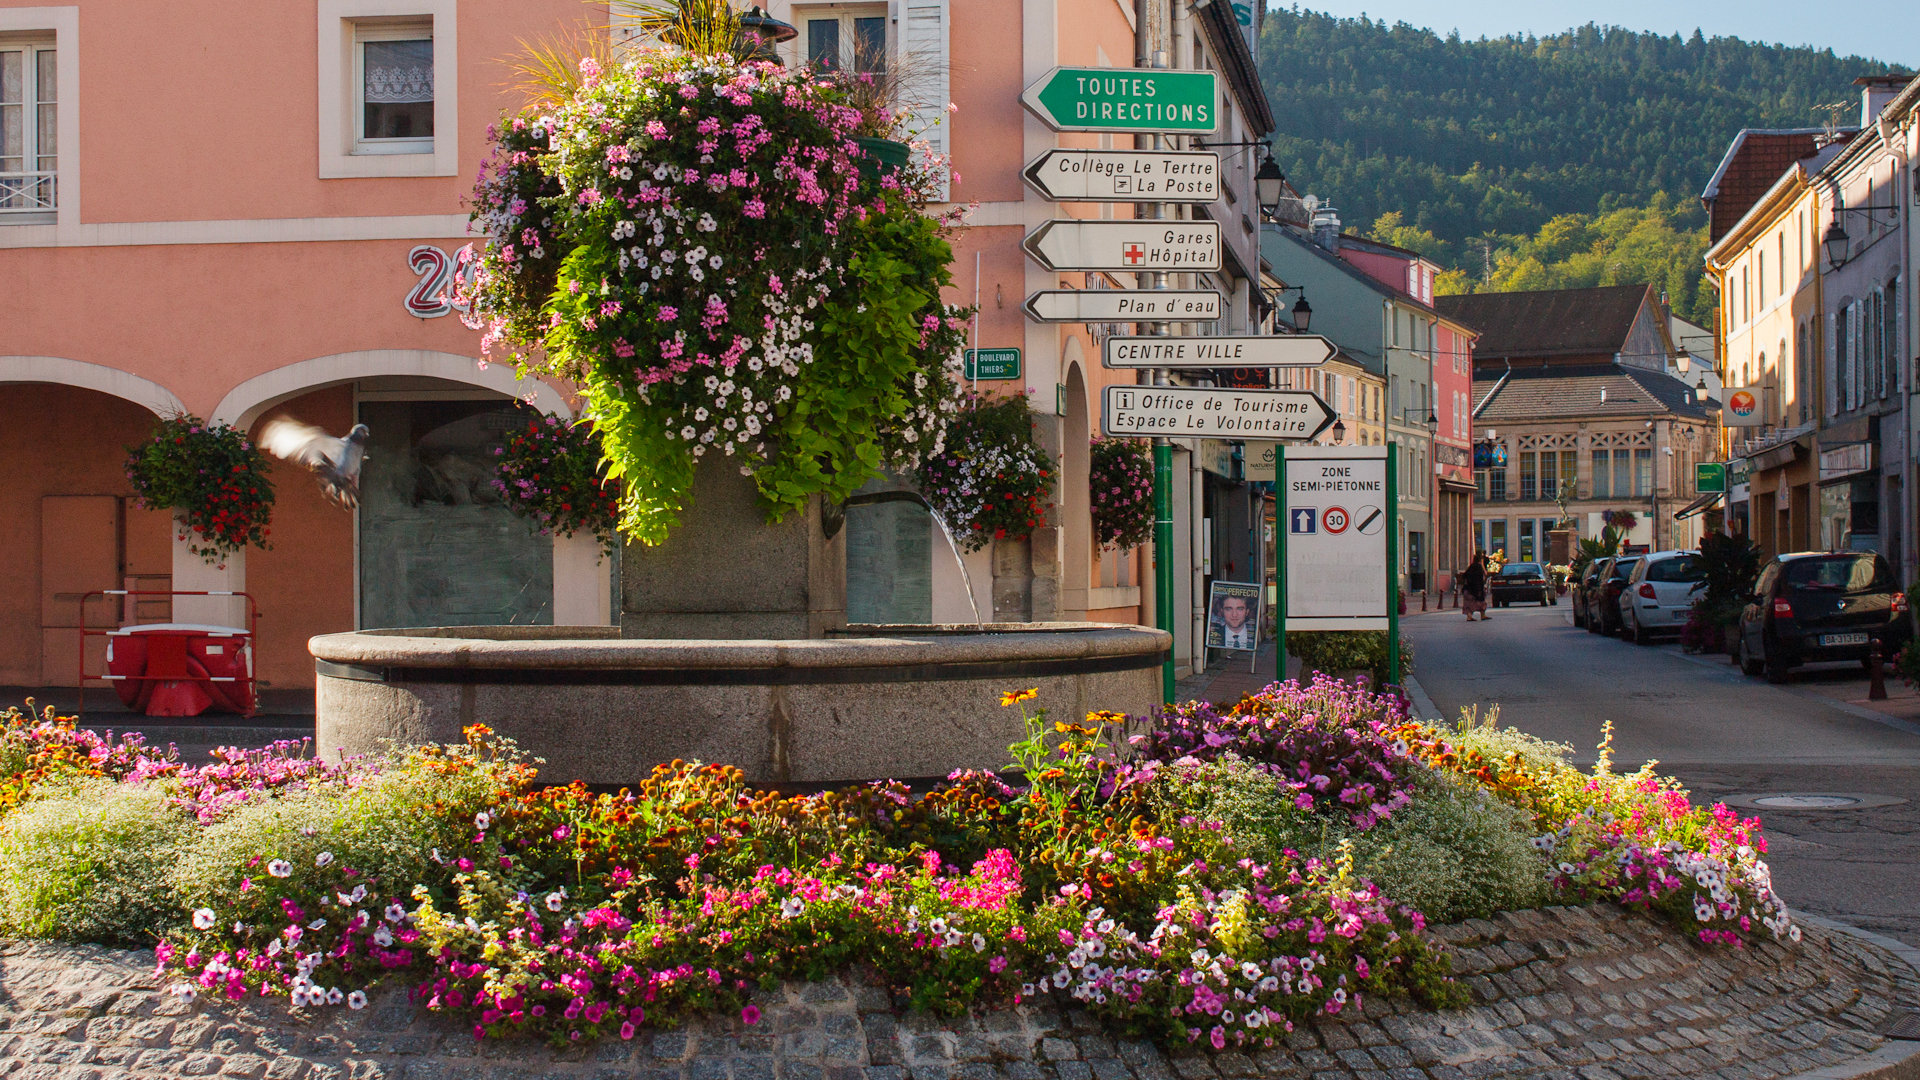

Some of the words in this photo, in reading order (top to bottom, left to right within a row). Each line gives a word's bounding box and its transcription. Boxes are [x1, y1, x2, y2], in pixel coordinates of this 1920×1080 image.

[1076, 77, 1156, 97] TOUTES
[1076, 101, 1208, 123] DIRECTIONS
[1059, 158, 1124, 177] Collège
[1133, 159, 1152, 174] Le
[1162, 160, 1213, 175] Tertre
[1137, 178, 1156, 192] La
[1165, 179, 1213, 193] Poste
[1163, 230, 1213, 245] Gares
[1149, 248, 1214, 266] Hôpital
[1118, 298, 1156, 313] Plan
[1166, 298, 1214, 313] d'eau
[979, 353, 1015, 362] BOULEVARD
[1117, 344, 1186, 359] CENTRE
[1197, 344, 1243, 359] VILLE
[980, 365, 1004, 374] THIERS
[1142, 394, 1194, 410] Office
[1203, 396, 1223, 411] de
[1233, 397, 1308, 414] Tourisme
[1735, 406, 1752, 415] PFG
[1116, 412, 1177, 431] Espace
[1186, 414, 1205, 429] Le
[1217, 415, 1306, 432] Volontaire
[1321, 467, 1351, 478] ZONE
[1292, 480, 1381, 492] SEMI-PIÉTONNE
[1328, 515, 1344, 526] 30
[1228, 588, 1258, 598] PERFECTO
